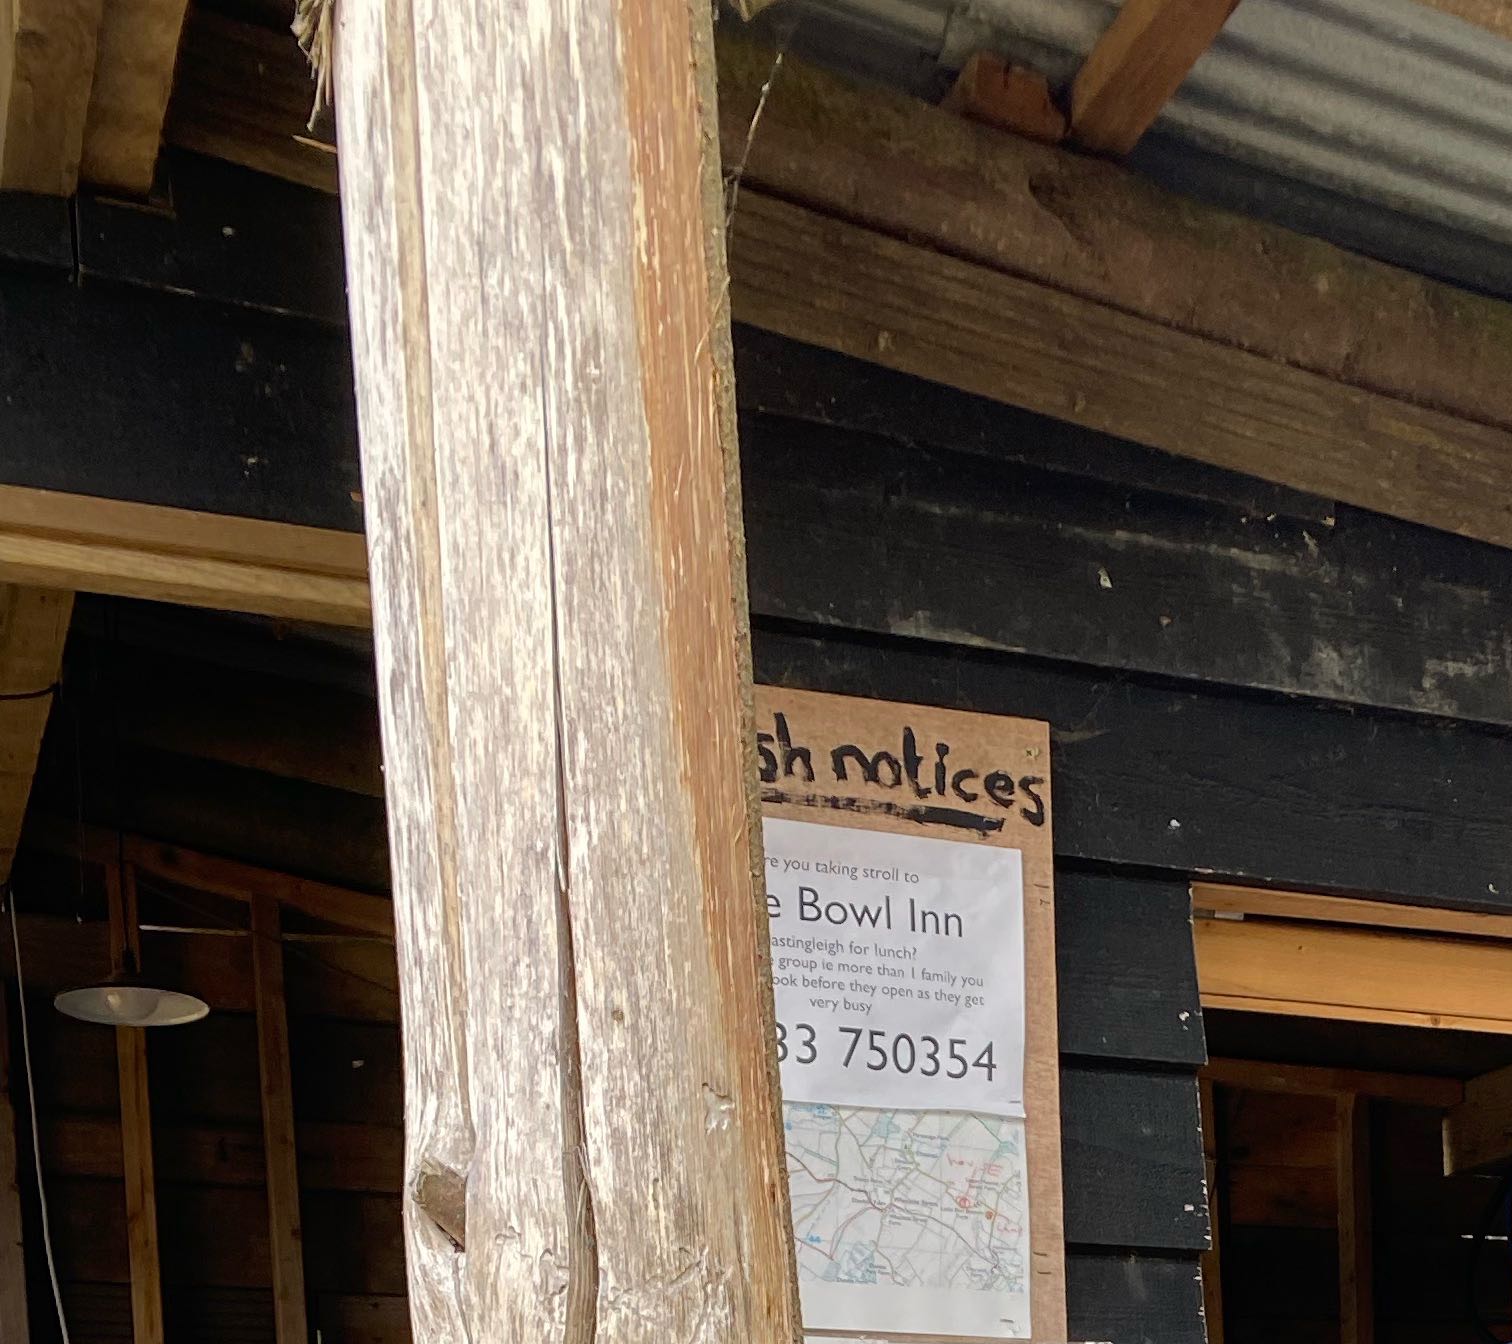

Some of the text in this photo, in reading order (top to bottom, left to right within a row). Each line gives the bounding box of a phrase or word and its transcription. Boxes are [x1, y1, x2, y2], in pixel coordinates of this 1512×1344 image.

[830, 726, 1045, 827] notices
[784, 859, 810, 873] you
[815, 860, 858, 880] taking
[862, 868, 899, 882] stroll
[904, 872, 920, 884] to
[799, 886, 891, 930] Bowl
[910, 898, 963, 938] Inn
[771, 935, 917, 960] astingleigh for lunch?
[778, 957, 817, 973] group
[838, 962, 873, 975] more
[877, 963, 904, 978] than
[921, 967, 957, 987] family
[961, 976, 984, 989] you
[773, 974, 985, 1008] ook before they open as they get
[809, 997, 873, 1016] very busy
[838, 1025, 997, 1082] 750354
